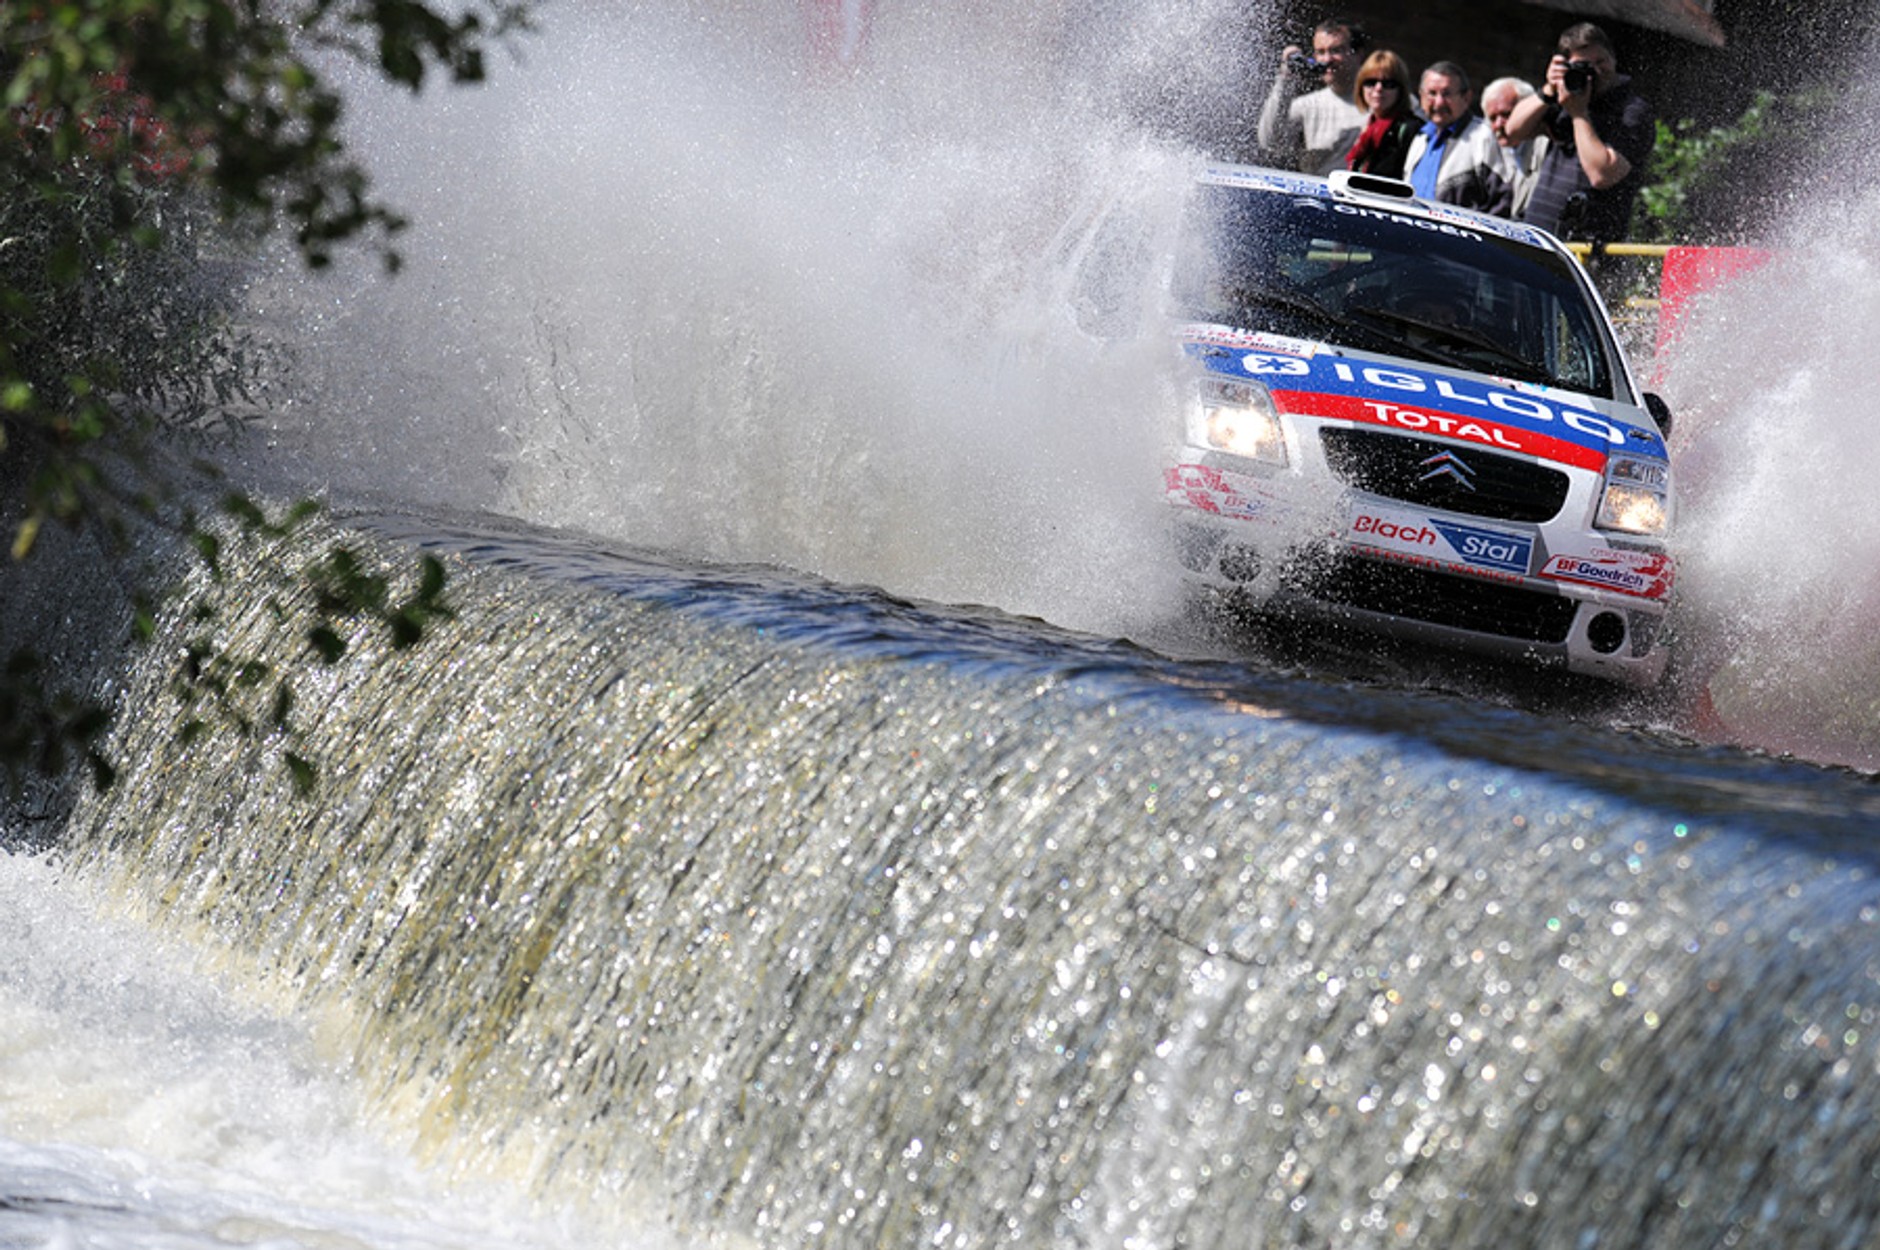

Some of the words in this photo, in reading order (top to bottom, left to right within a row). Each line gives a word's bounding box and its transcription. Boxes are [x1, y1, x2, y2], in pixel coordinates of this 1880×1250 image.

[1334, 362, 1625, 445] IGLOO
[1364, 401, 1522, 449] TOTAL
[1353, 515, 1437, 545] Blach
[1462, 536, 1518, 562] Stal
[1556, 558, 1644, 586] BFGoodrich
